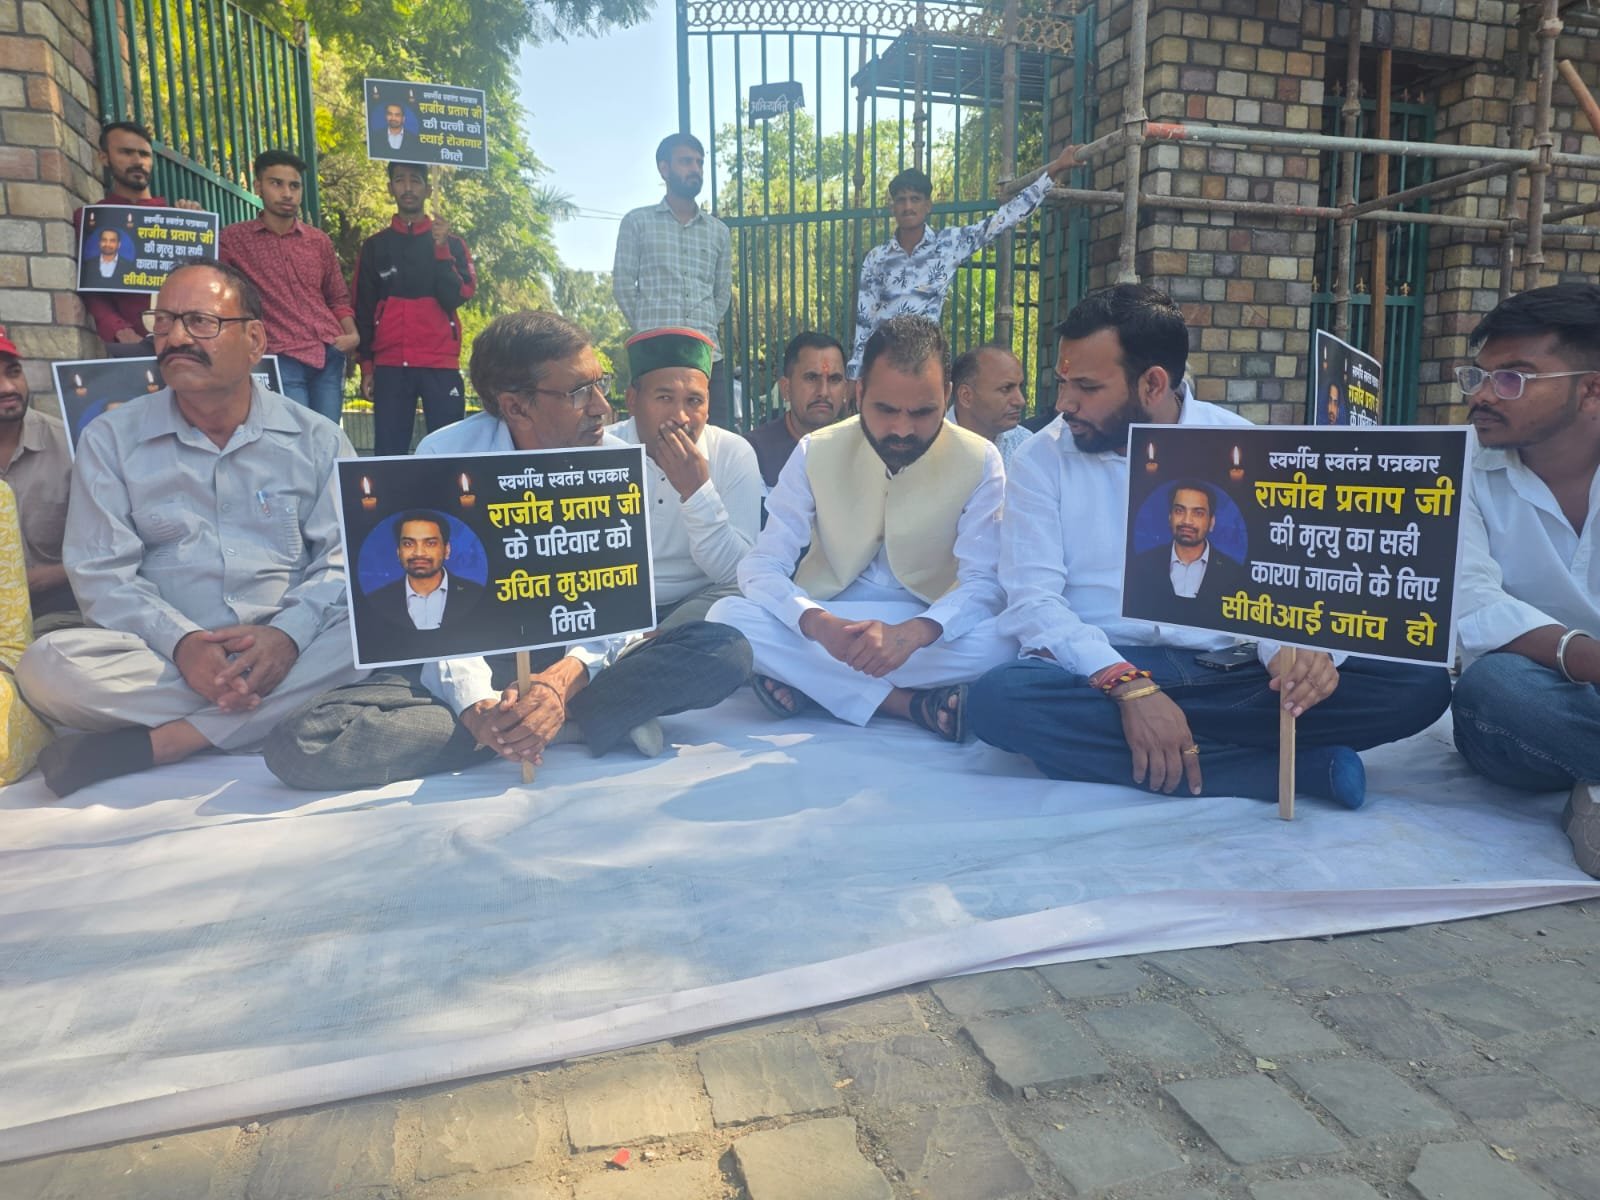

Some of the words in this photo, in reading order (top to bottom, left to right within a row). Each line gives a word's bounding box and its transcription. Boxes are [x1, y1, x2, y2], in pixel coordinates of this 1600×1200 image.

[419, 100, 445, 115] राजीव
[447, 105, 469, 118] प्रताप
[471, 105, 482, 119] जी
[422, 117, 437, 129] की
[440, 120, 465, 132] पत्नी
[466, 122, 481, 134] को
[441, 148, 463, 161] मिले
[137, 224, 168, 240] राजीव
[170, 229, 196, 242] प्रताप
[200, 229, 214, 244] जी
[144, 240, 155, 254] की
[156, 243, 174, 258] मृत्यु
[175, 245, 187, 256] का
[136, 259, 158, 270] कारण
[1268, 446, 1320, 470] स्वर्गीय
[1324, 446, 1372, 472] स्वतंत्र
[1377, 454, 1441, 474] पत्रकार
[497, 467, 544, 491] स्वर्गीय
[547, 465, 584, 488] स्वतंत्र
[587, 467, 630, 485] पत्रकार
[1254, 471, 1327, 509] राजीव
[1335, 484, 1405, 514] प्रताप
[1415, 475, 1455, 516] जी
[487, 491, 554, 528] राजीव
[560, 495, 611, 522] प्रताप
[616, 482, 641, 515] जी
[502, 529, 529, 560] के
[534, 525, 601, 557] परिवार
[604, 518, 632, 550] को
[1269, 514, 1295, 546] की
[1299, 524, 1341, 558] मृत्यु
[1346, 527, 1374, 553] का
[1379, 522, 1421, 557] सही
[495, 569, 551, 602] उचित
[556, 564, 639, 602] मुआवजा
[1250, 560, 1300, 588] कारण
[1304, 562, 1363, 596] जानने
[1368, 565, 1392, 597] के
[1396, 566, 1440, 602] लिए
[549, 601, 596, 635] मिले
[1221, 590, 1325, 636] सीबीआई
[1330, 609, 1388, 641] जांच
[1405, 611, 1438, 646] हो
